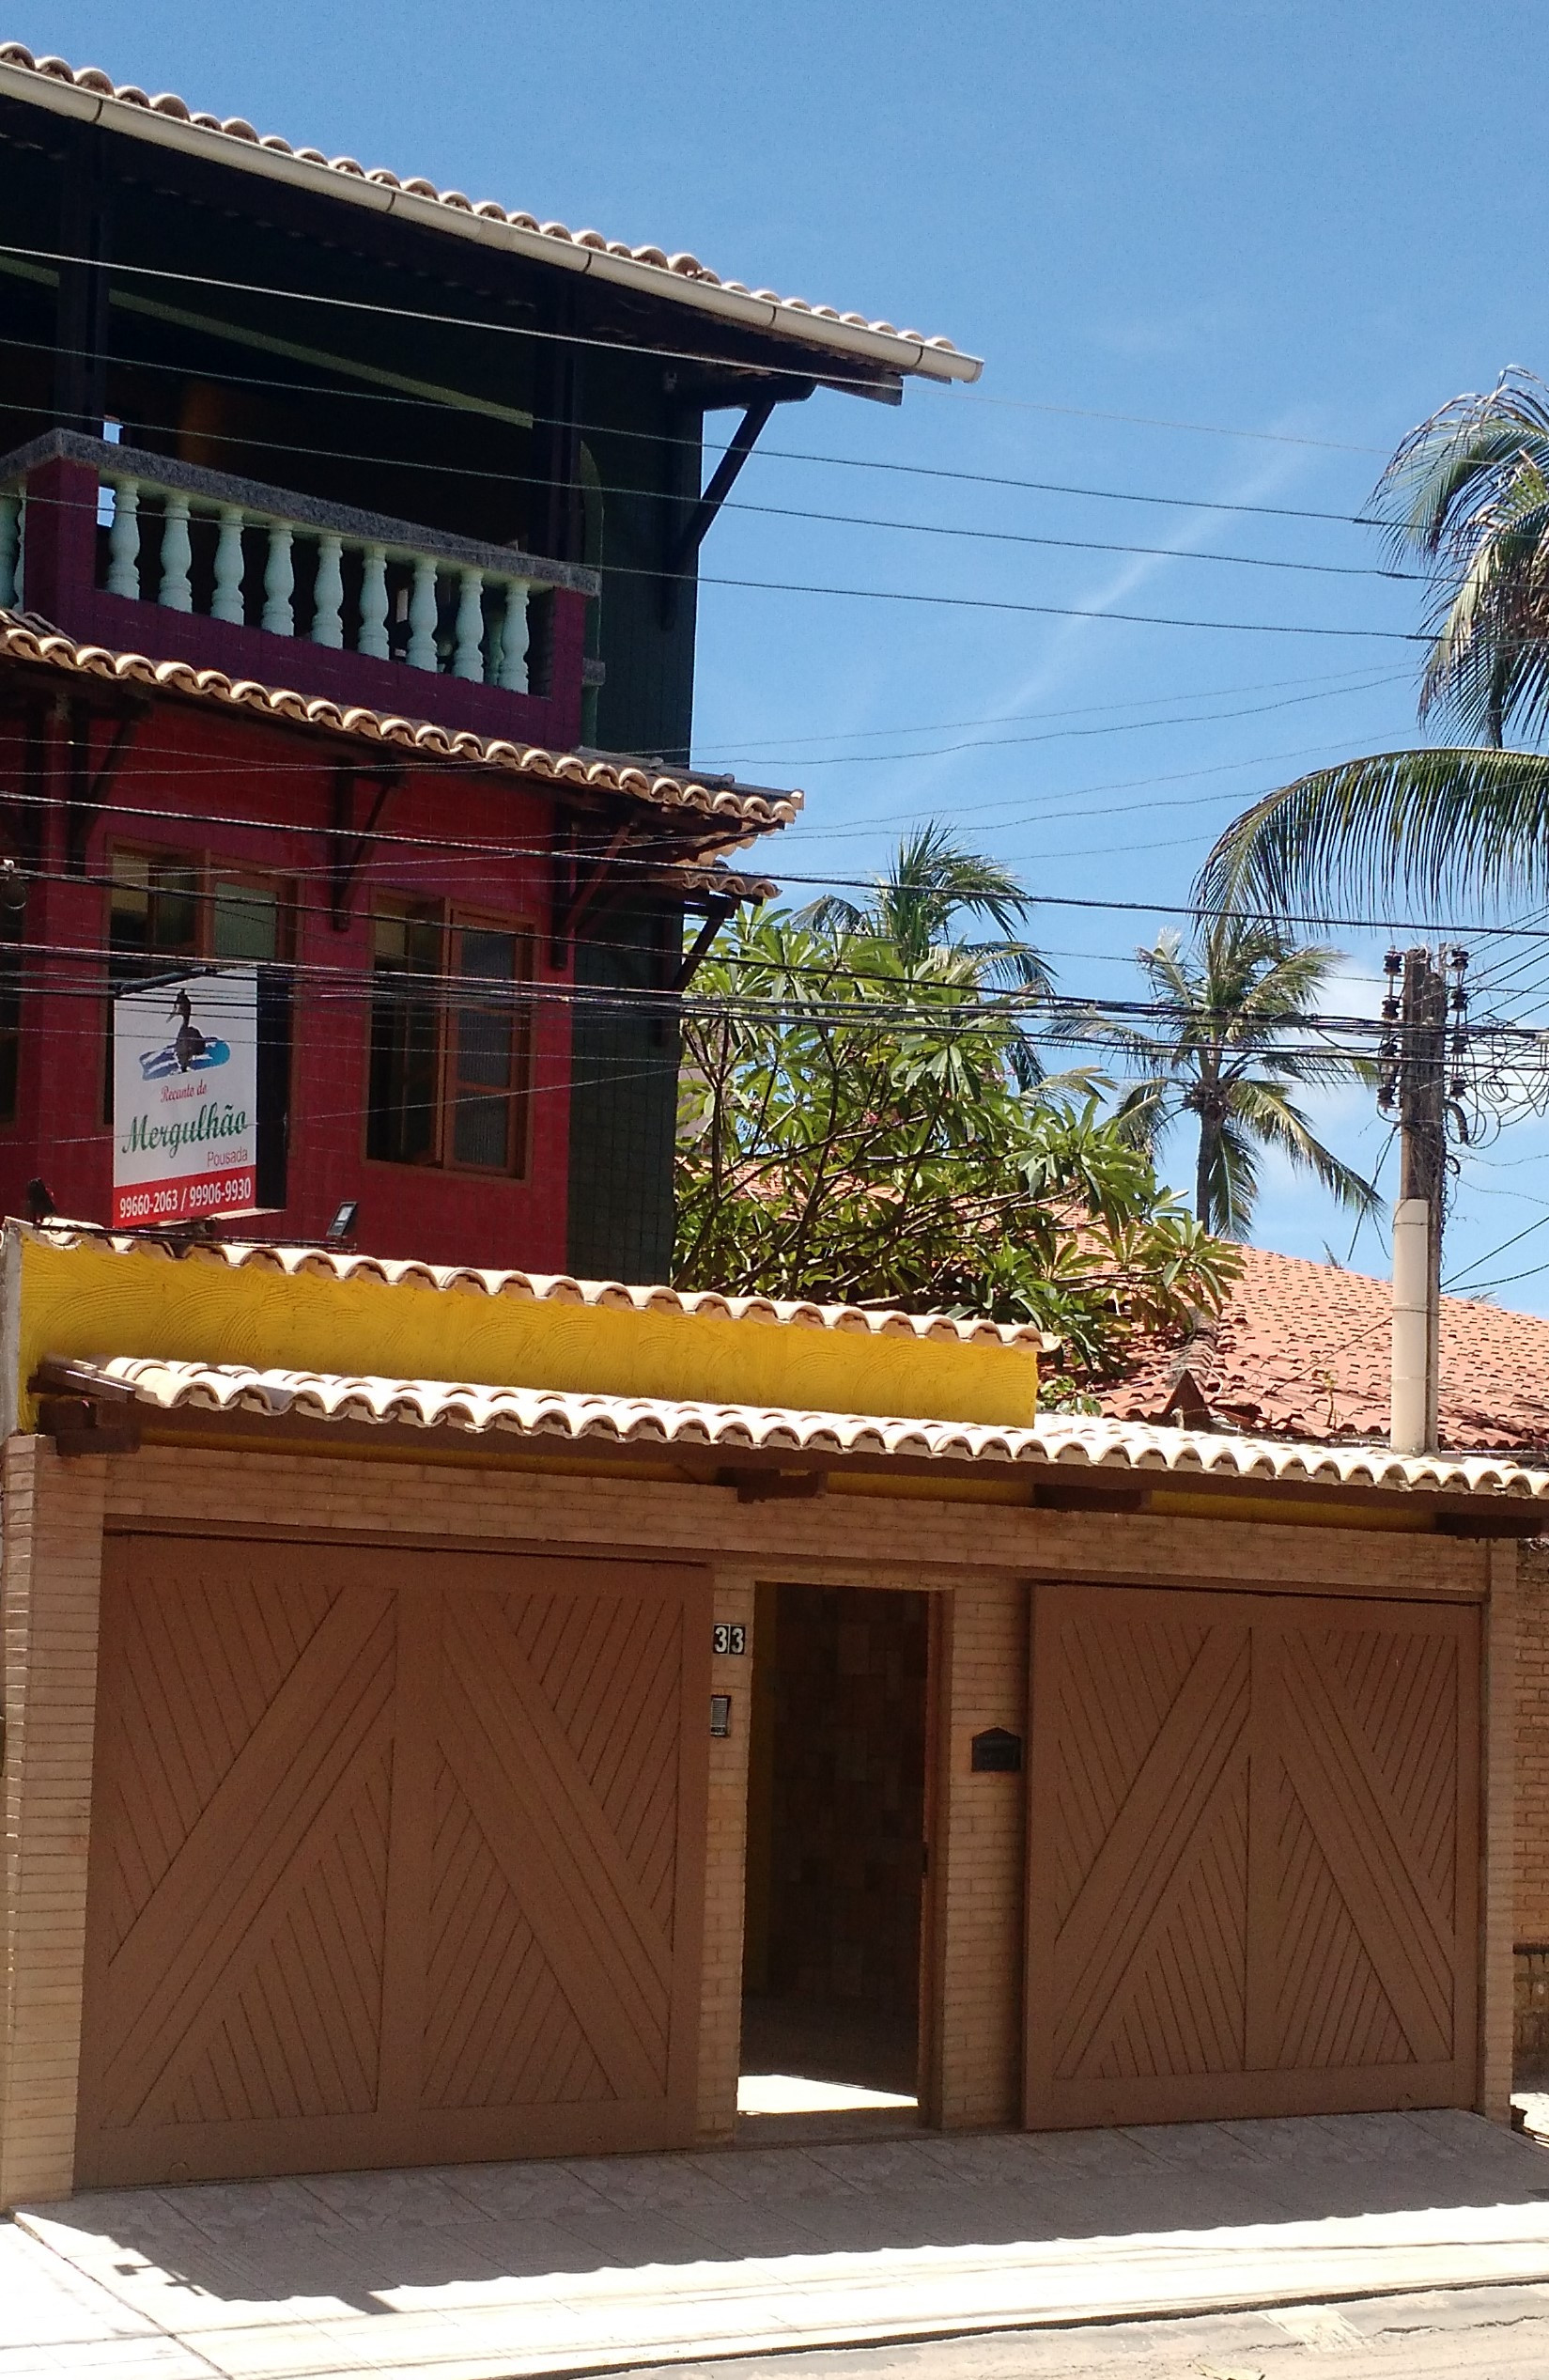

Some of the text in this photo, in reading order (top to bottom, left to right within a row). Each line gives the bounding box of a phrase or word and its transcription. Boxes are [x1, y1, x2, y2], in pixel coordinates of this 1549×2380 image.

[161, 1080, 207, 1102] Recanto do
[122, 1102, 247, 1158] Mergulhão
[207, 1146, 248, 1167] Pousada
[119, 1190, 178, 1218] 99660-2063
[189, 1177, 251, 1206] 99906-9930
[714, 1626, 743, 1653] 33
